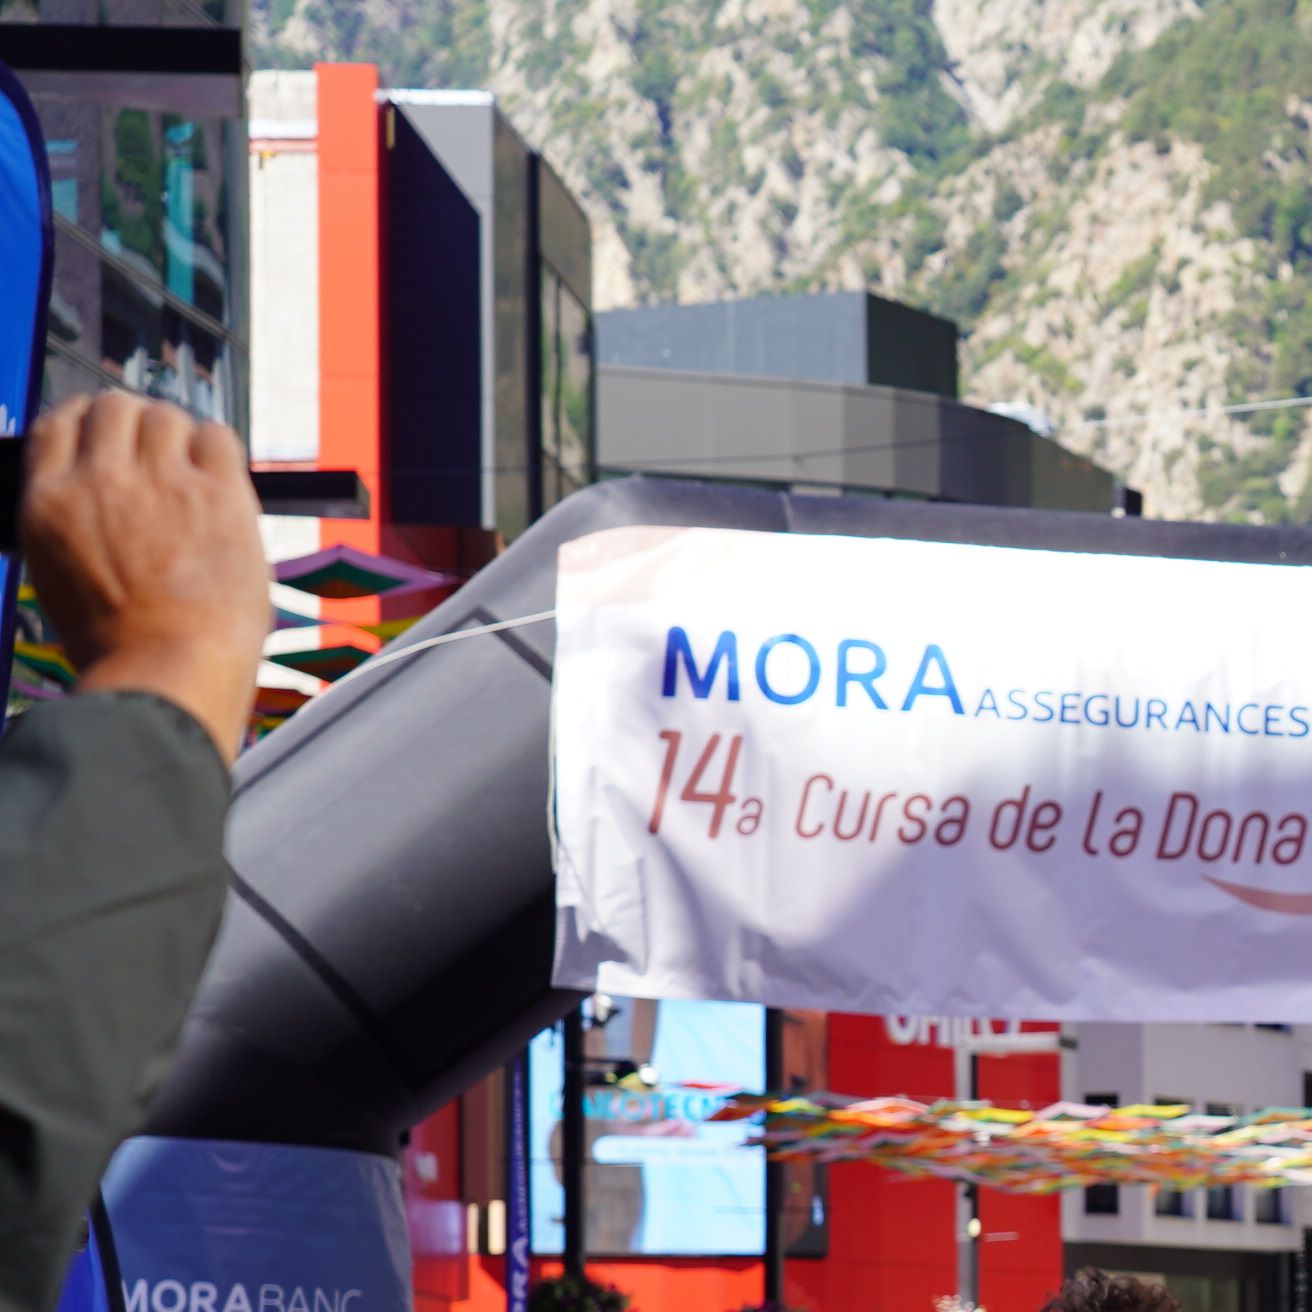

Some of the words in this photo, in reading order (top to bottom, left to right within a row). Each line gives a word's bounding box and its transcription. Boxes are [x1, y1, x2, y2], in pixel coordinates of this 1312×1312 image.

[661, 626, 966, 715] MORA
[975, 687, 1311, 738] ASSEGURANCES
[648, 731, 764, 840] 14a
[795, 774, 970, 847] Cursa
[990, 784, 1061, 853] de
[1083, 789, 1144, 858] la
[1156, 793, 1309, 866] Dona
